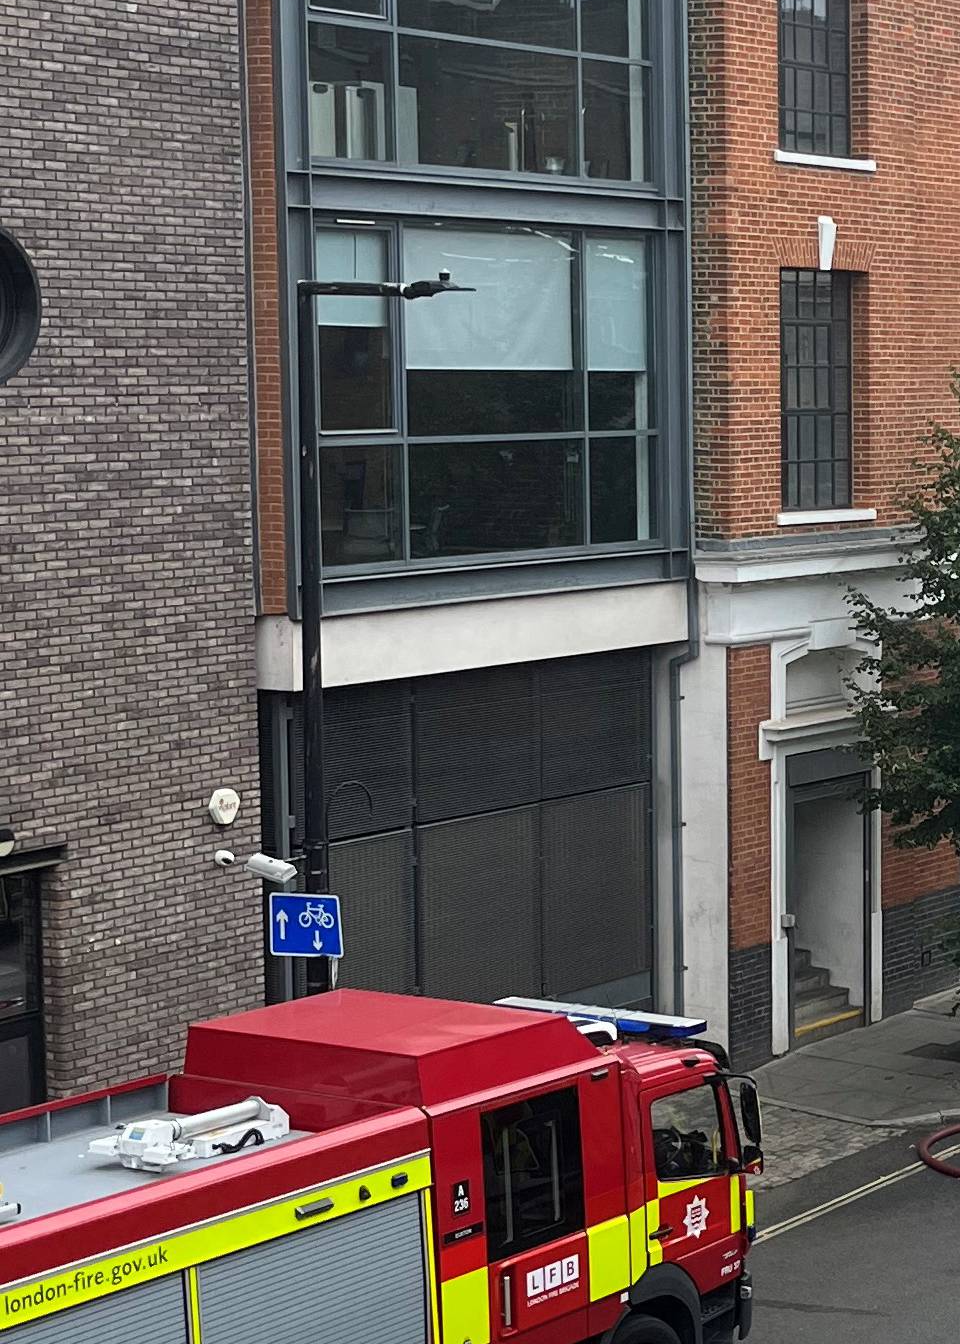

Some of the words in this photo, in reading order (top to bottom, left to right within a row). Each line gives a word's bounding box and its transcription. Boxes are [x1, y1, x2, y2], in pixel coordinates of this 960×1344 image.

[457, 1184, 465, 1197] A
[454, 1197, 469, 1213] 236
[4, 1245, 169, 1315] london-fire.gov.uk
